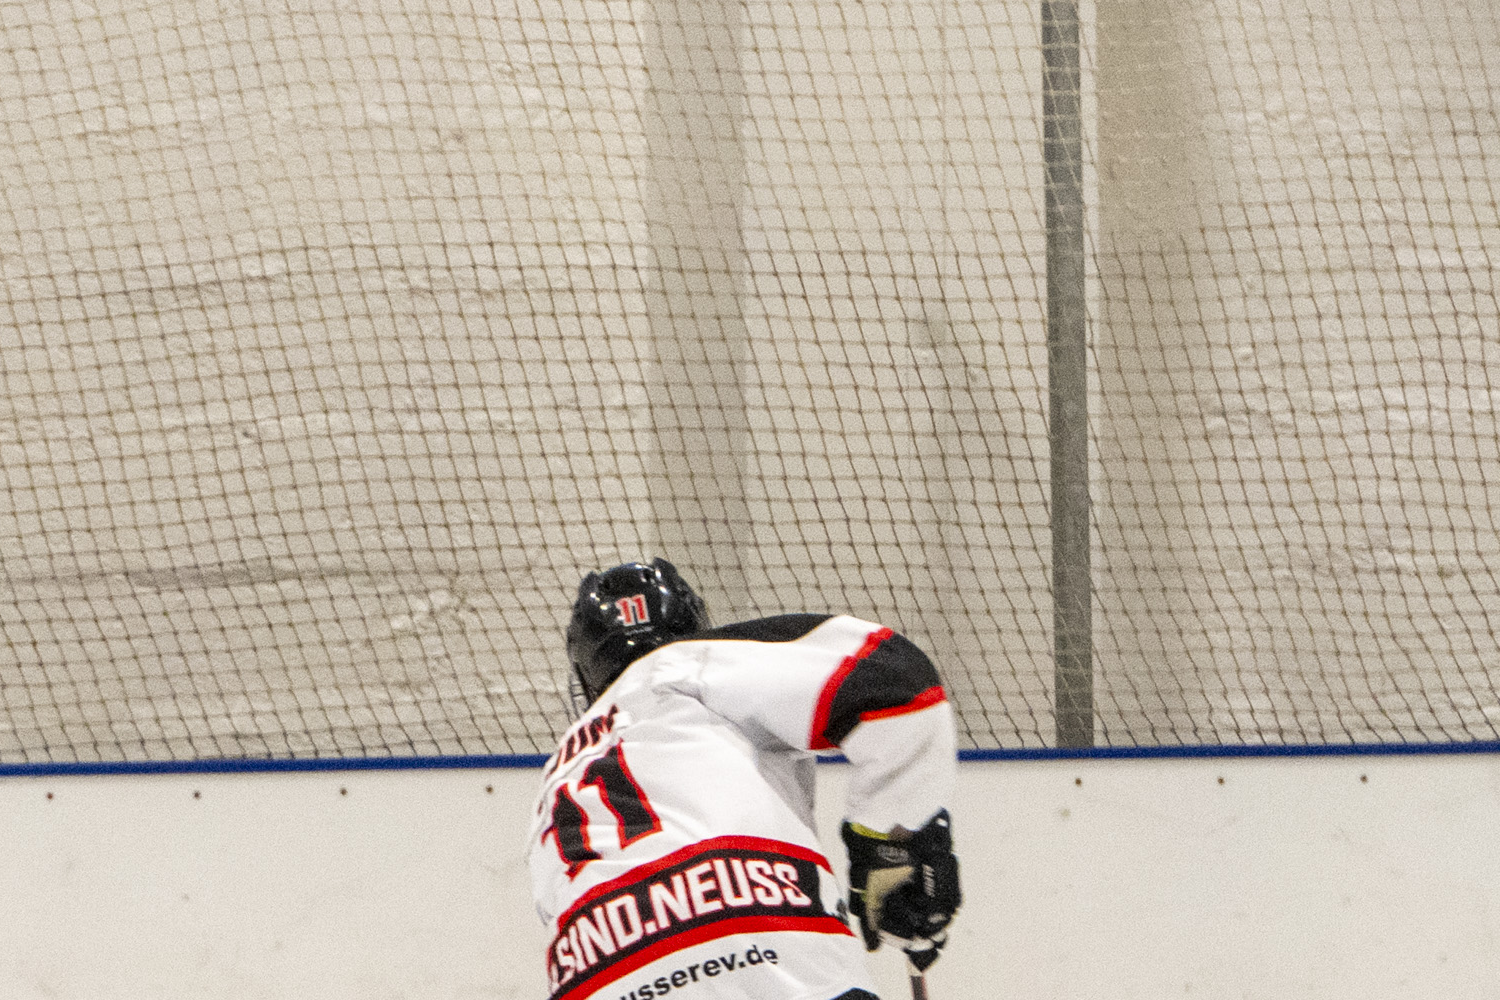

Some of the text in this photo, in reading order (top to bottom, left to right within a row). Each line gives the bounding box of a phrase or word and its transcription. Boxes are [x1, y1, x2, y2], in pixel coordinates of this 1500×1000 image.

[615, 594, 649, 627] 11
[541, 737, 664, 883] 11
[548, 857, 813, 992] SIND.NEUSS
